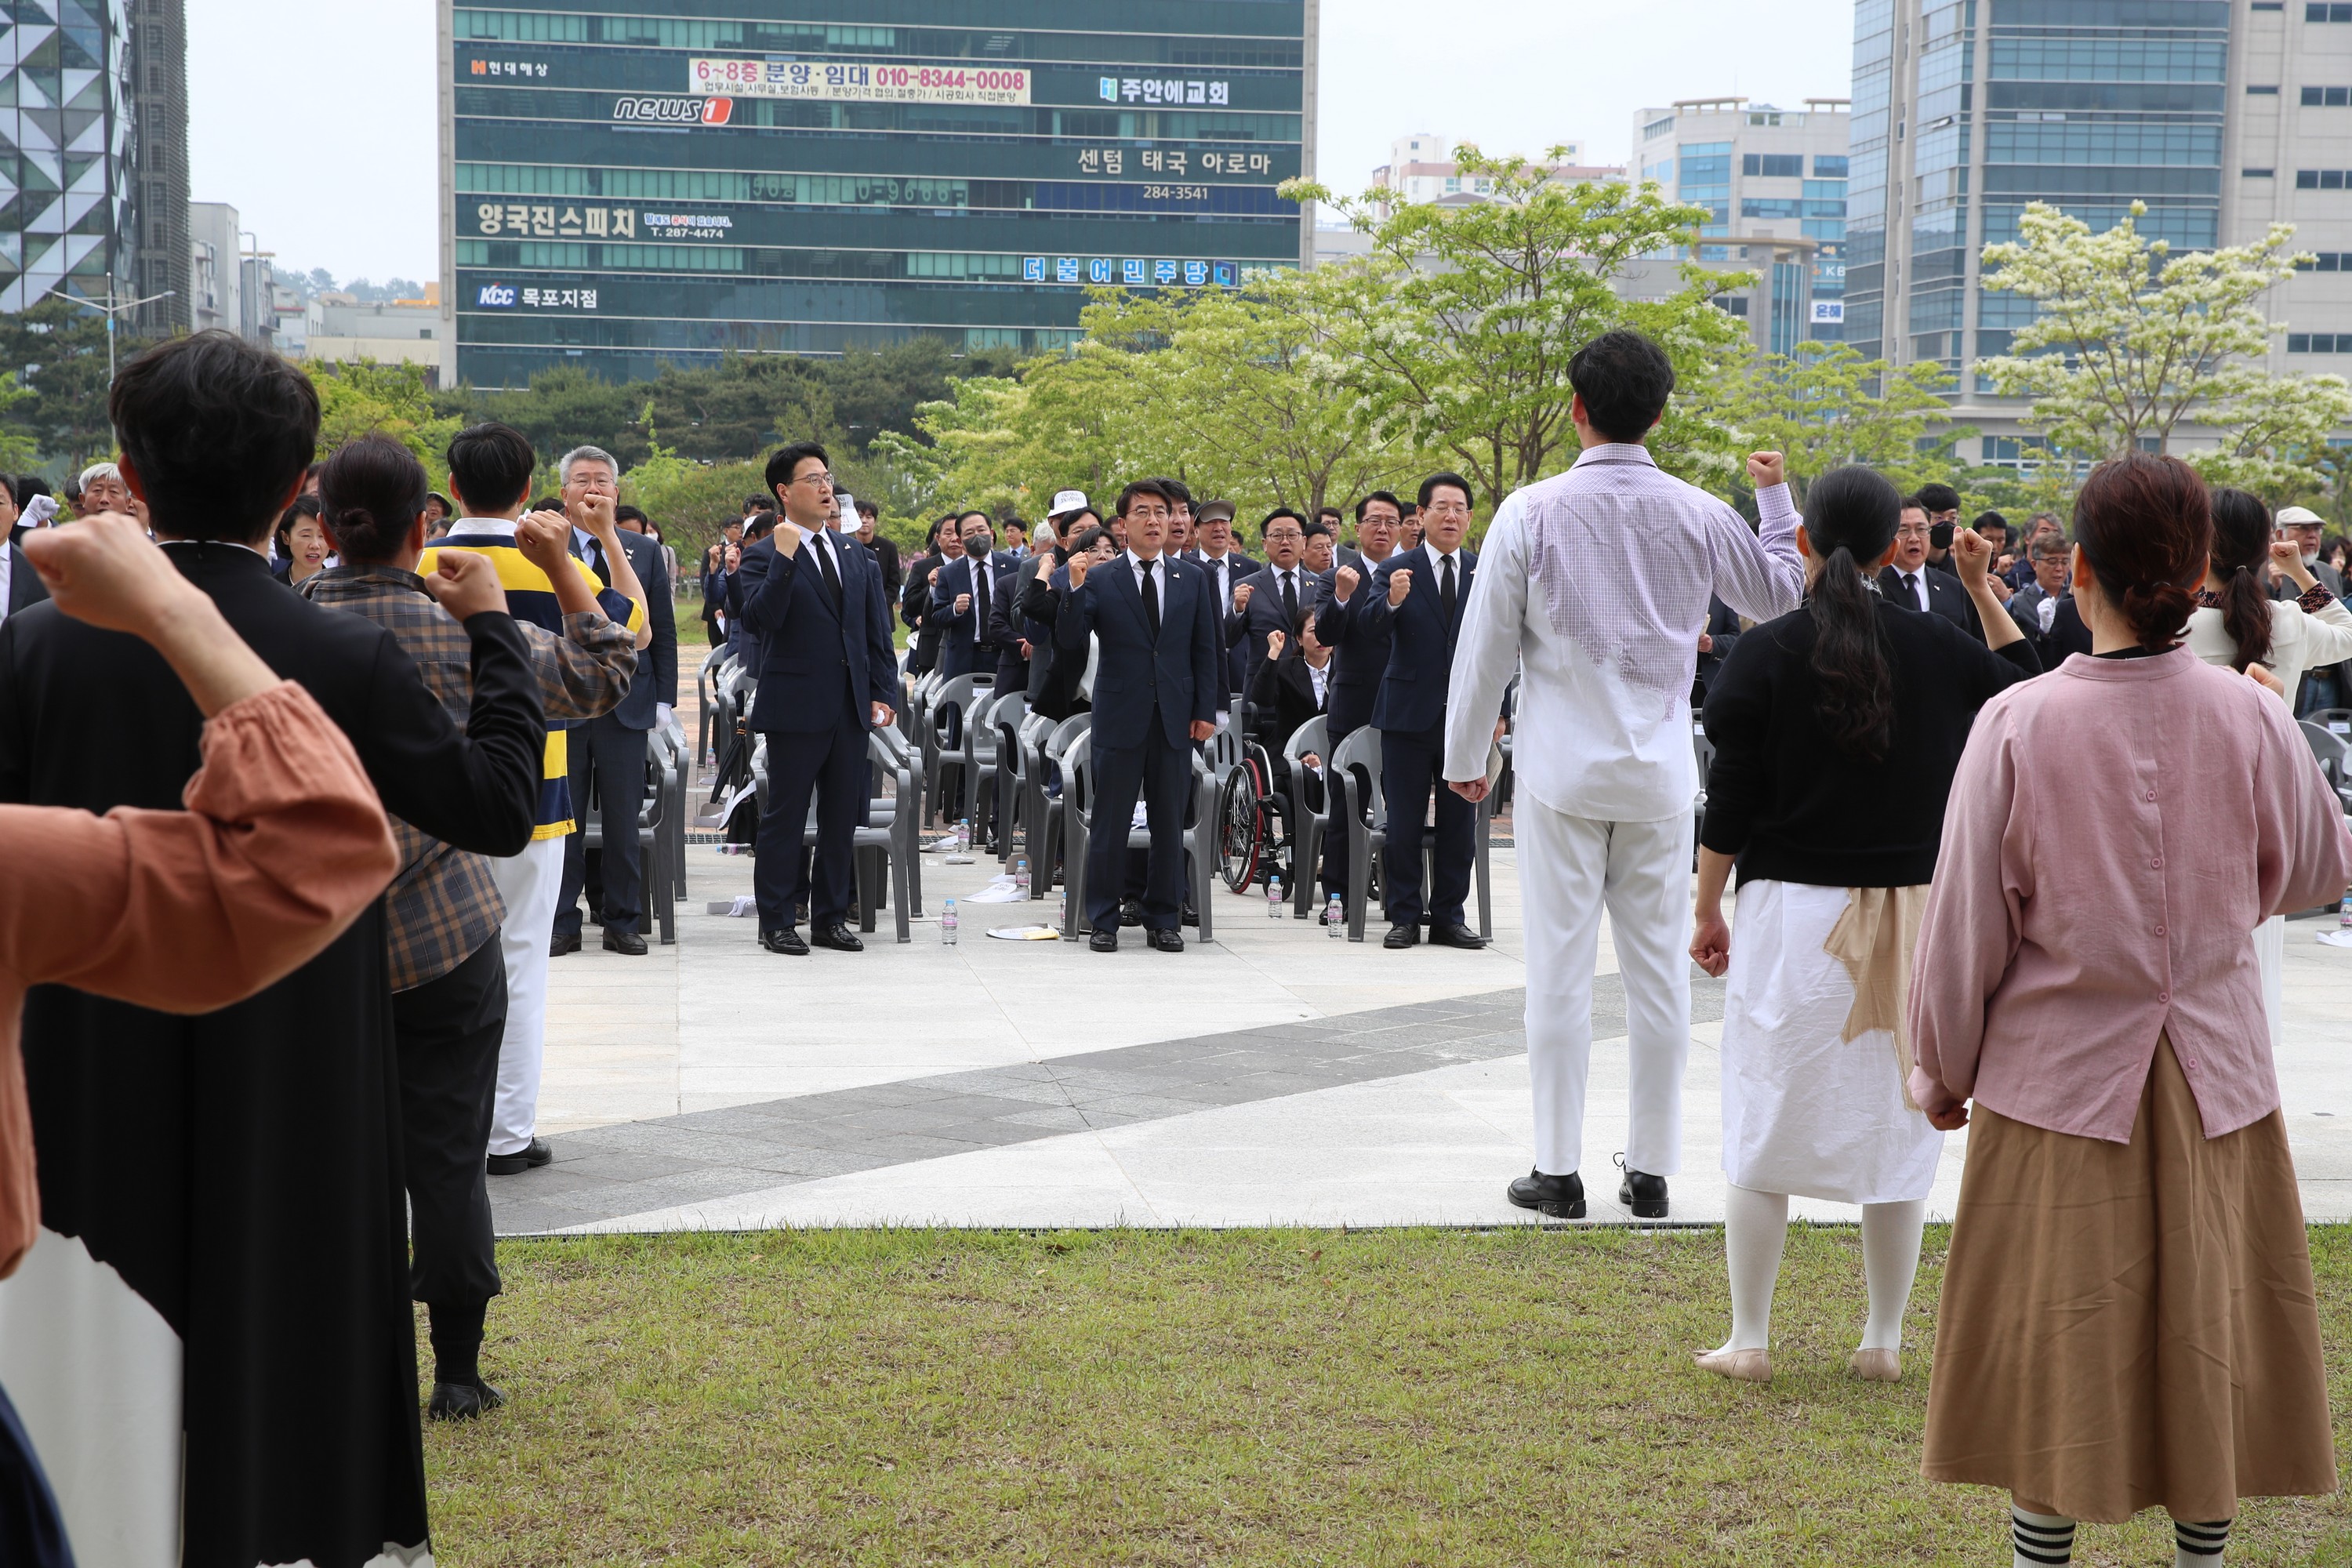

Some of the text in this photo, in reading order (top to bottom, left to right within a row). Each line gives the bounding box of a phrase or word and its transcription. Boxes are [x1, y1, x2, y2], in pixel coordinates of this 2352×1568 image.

[489, 61, 548, 78] 현대해상
[697, 60, 757, 82] 6~8층
[877, 67, 1024, 90] 010-8344-0008
[935, 89, 974, 102] 시공회사
[1122, 78, 1229, 105] 주안에교회
[1077, 149, 1271, 176] 센텀 태국 아로마
[1143, 186, 1207, 200] 284-3541
[478, 203, 635, 239] 양국진스피치
[651, 227, 724, 238] T. 287-4474
[1023, 257, 1208, 285] 더불어민주당
[479, 283, 515, 307] KCC
[522, 288, 597, 309] 목포지점
